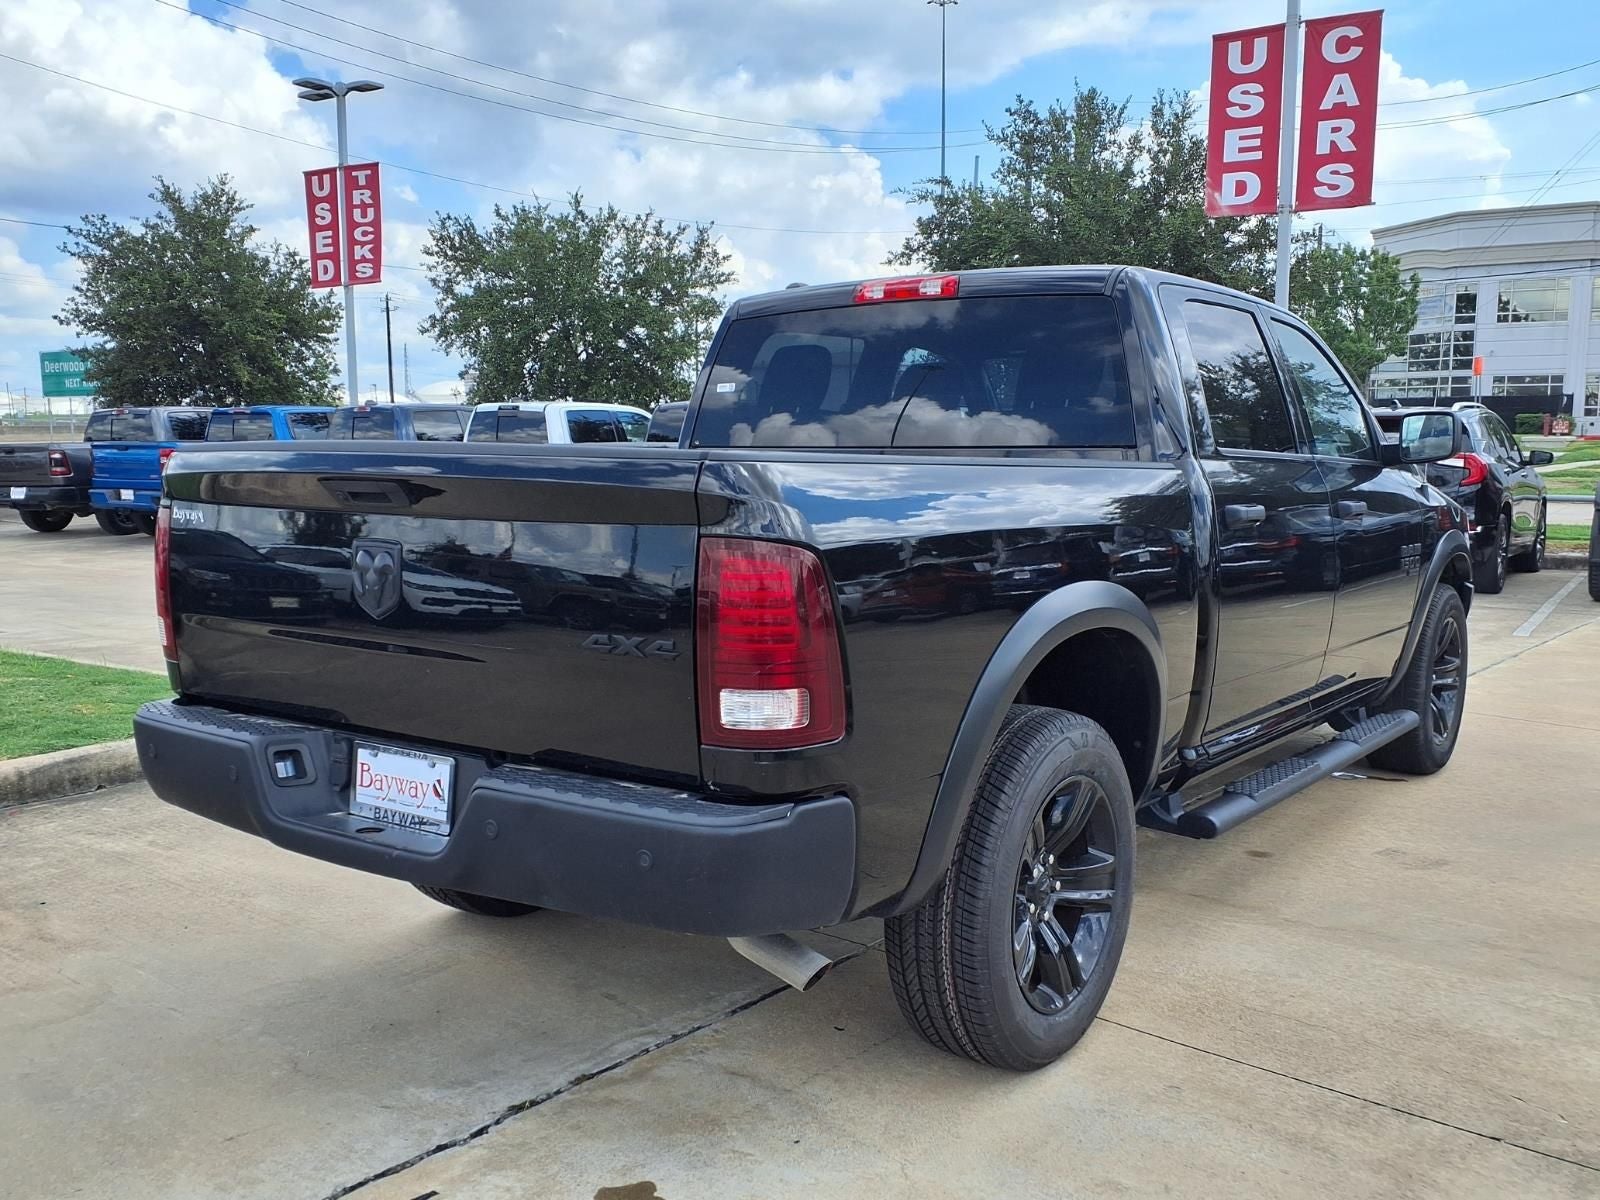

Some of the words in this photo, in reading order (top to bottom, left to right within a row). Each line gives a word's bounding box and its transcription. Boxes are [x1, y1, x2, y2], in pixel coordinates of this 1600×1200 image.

[1220, 36, 1269, 206] USED
[1313, 26, 1364, 198] CARS
[311, 173, 335, 282] USED
[351, 169, 375, 278] TRUCKS
[44, 360, 85, 373] Deerwood
[65, 378, 81, 388] NEXT
[357, 761, 430, 809] Bayway
[373, 806, 426, 829] BAYWAY
